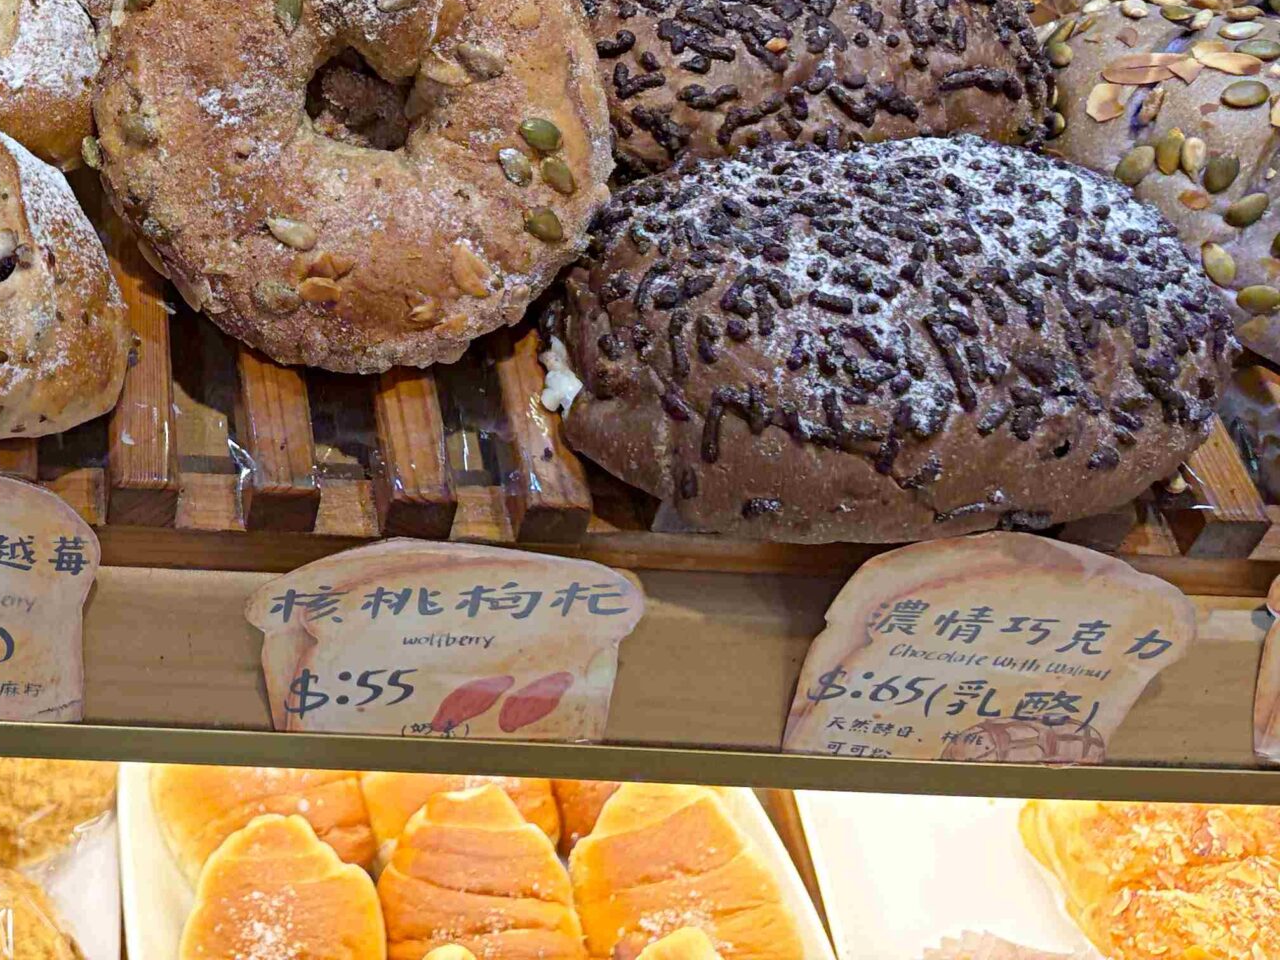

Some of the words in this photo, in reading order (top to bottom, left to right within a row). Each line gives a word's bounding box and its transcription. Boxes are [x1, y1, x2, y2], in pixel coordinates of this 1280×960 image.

[269, 581, 631, 624] 核桃枸杞
[403, 632, 496, 649] wolfberry
[867, 599, 1174, 661] 濃情巧克力
[889, 643, 989, 666] Chocolate
